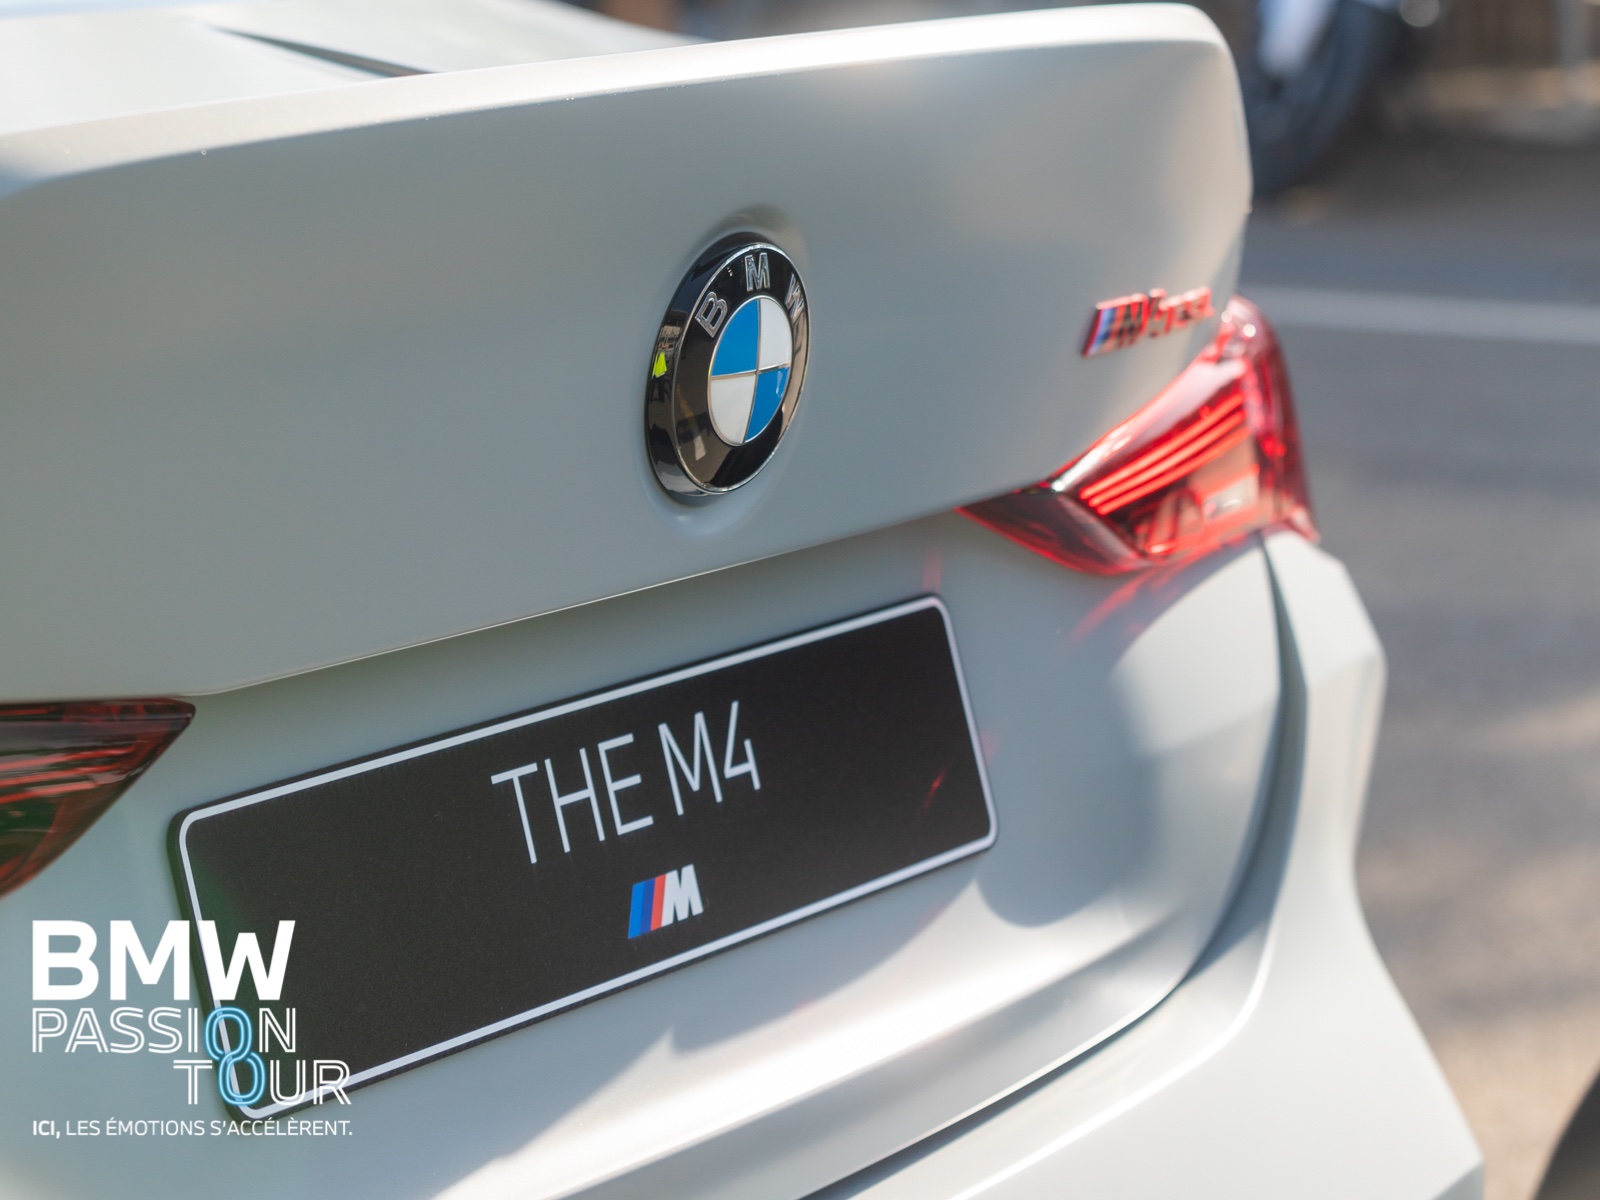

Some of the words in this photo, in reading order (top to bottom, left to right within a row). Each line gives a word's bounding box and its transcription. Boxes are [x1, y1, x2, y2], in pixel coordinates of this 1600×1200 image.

[695, 252, 804, 338] BMW
[491, 733, 654, 864] THE
[658, 700, 761, 816] M4
